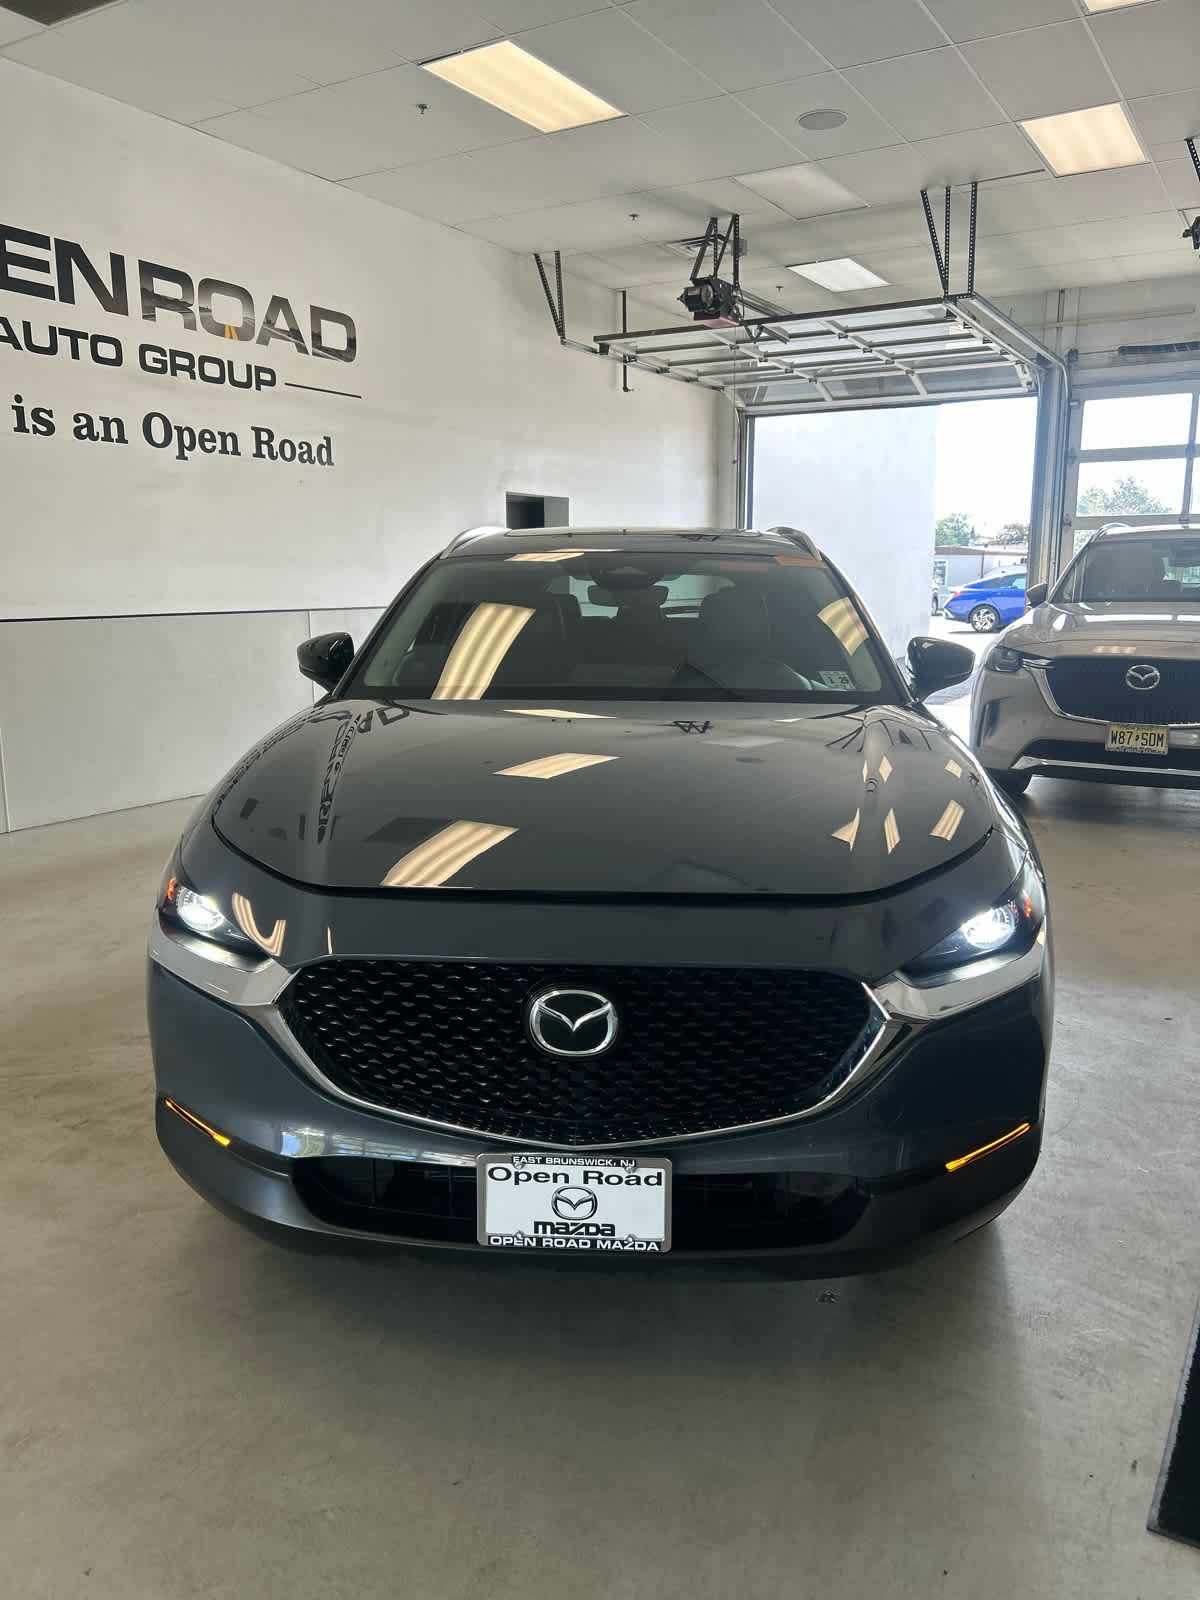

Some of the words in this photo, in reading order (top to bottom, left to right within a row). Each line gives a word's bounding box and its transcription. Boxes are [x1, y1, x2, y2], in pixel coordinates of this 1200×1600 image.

[138, 343, 277, 391] GROUP
[11, 394, 56, 437] is
[72, 411, 129, 445] an
[142, 411, 242, 461] Open
[250, 425, 335, 467] Road
[512, 1156, 542, 1164] EAST
[545, 1157, 617, 1167] BRUNSWICK,
[620, 1159, 635, 1167] NJ
[488, 1166, 570, 1185] Open
[583, 1170, 663, 1186] Road
[489, 1236, 537, 1247] OPEN
[542, 1237, 591, 1248] ROAD
[596, 1239, 660, 1251] MAZDA
